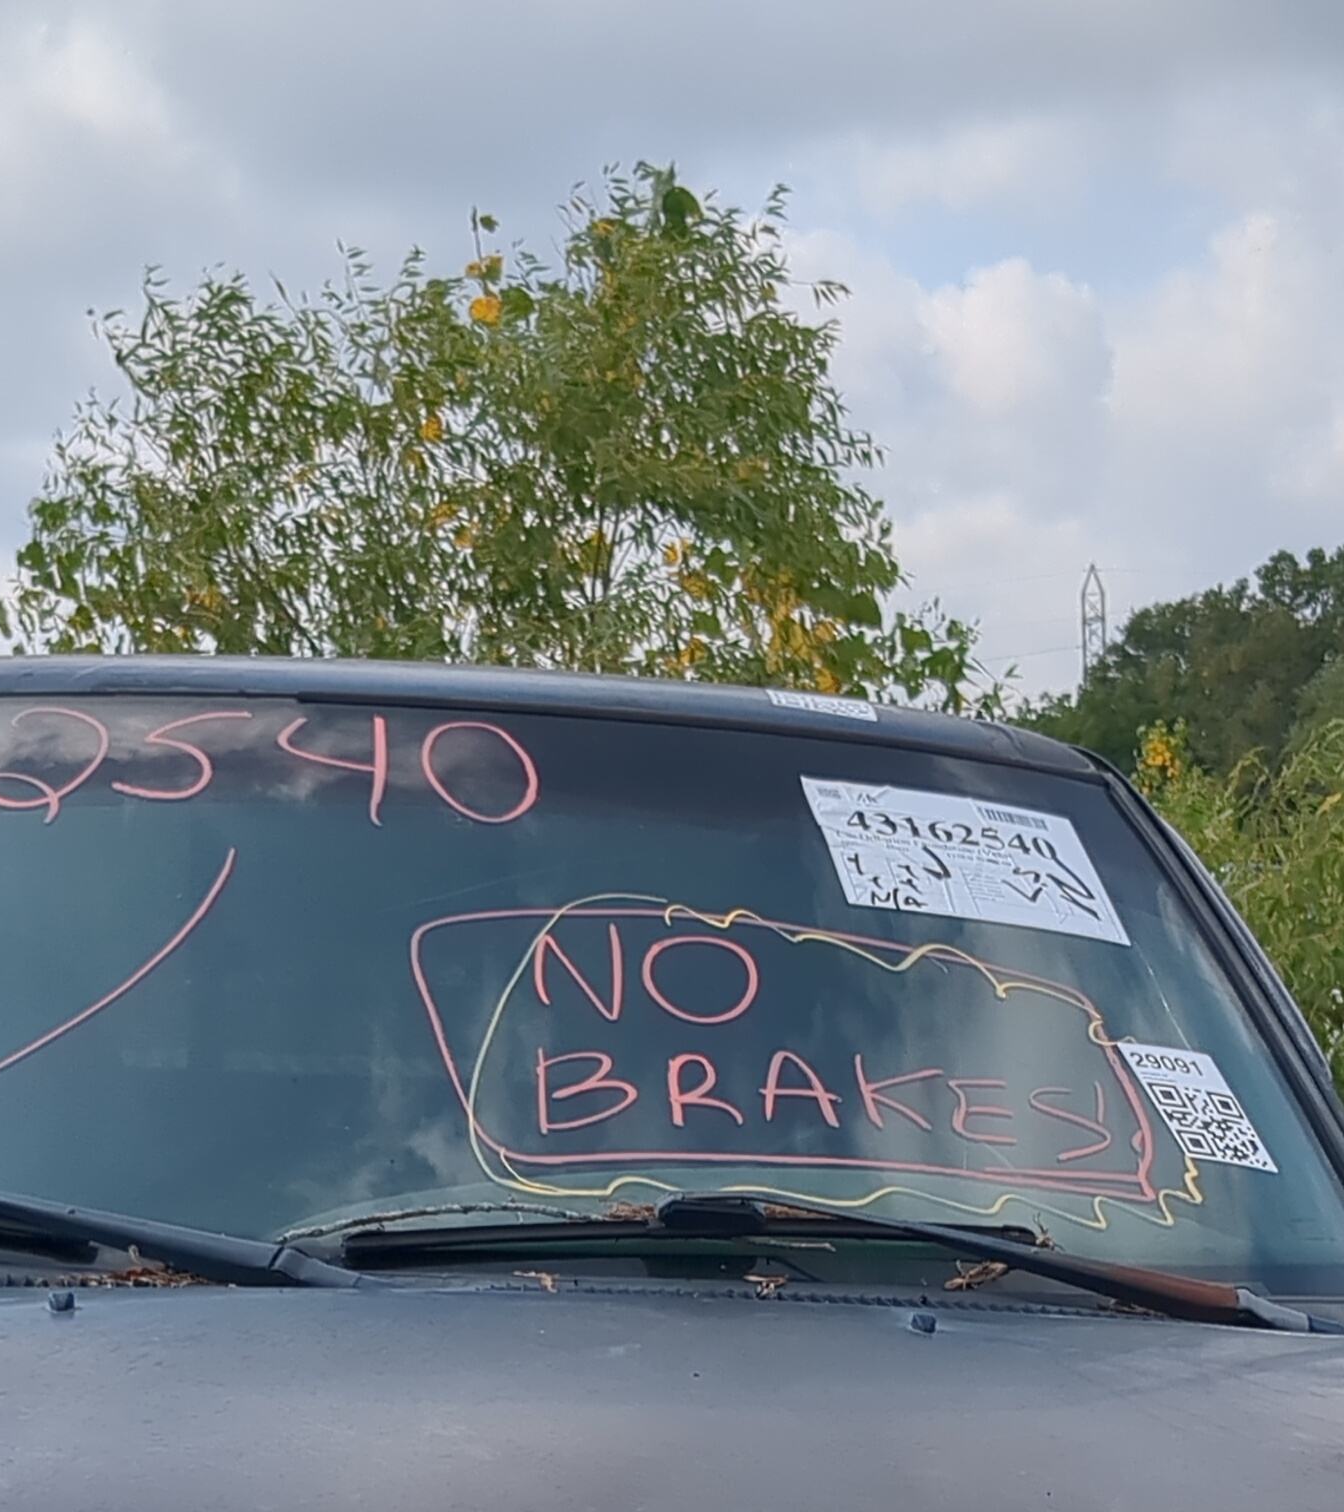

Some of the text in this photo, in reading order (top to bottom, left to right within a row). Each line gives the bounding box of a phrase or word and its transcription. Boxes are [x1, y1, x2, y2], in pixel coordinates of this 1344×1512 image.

[846, 809, 1058, 861] 43162540
[534, 922, 759, 1025] NO
[1129, 1051, 1204, 1077] 29091
